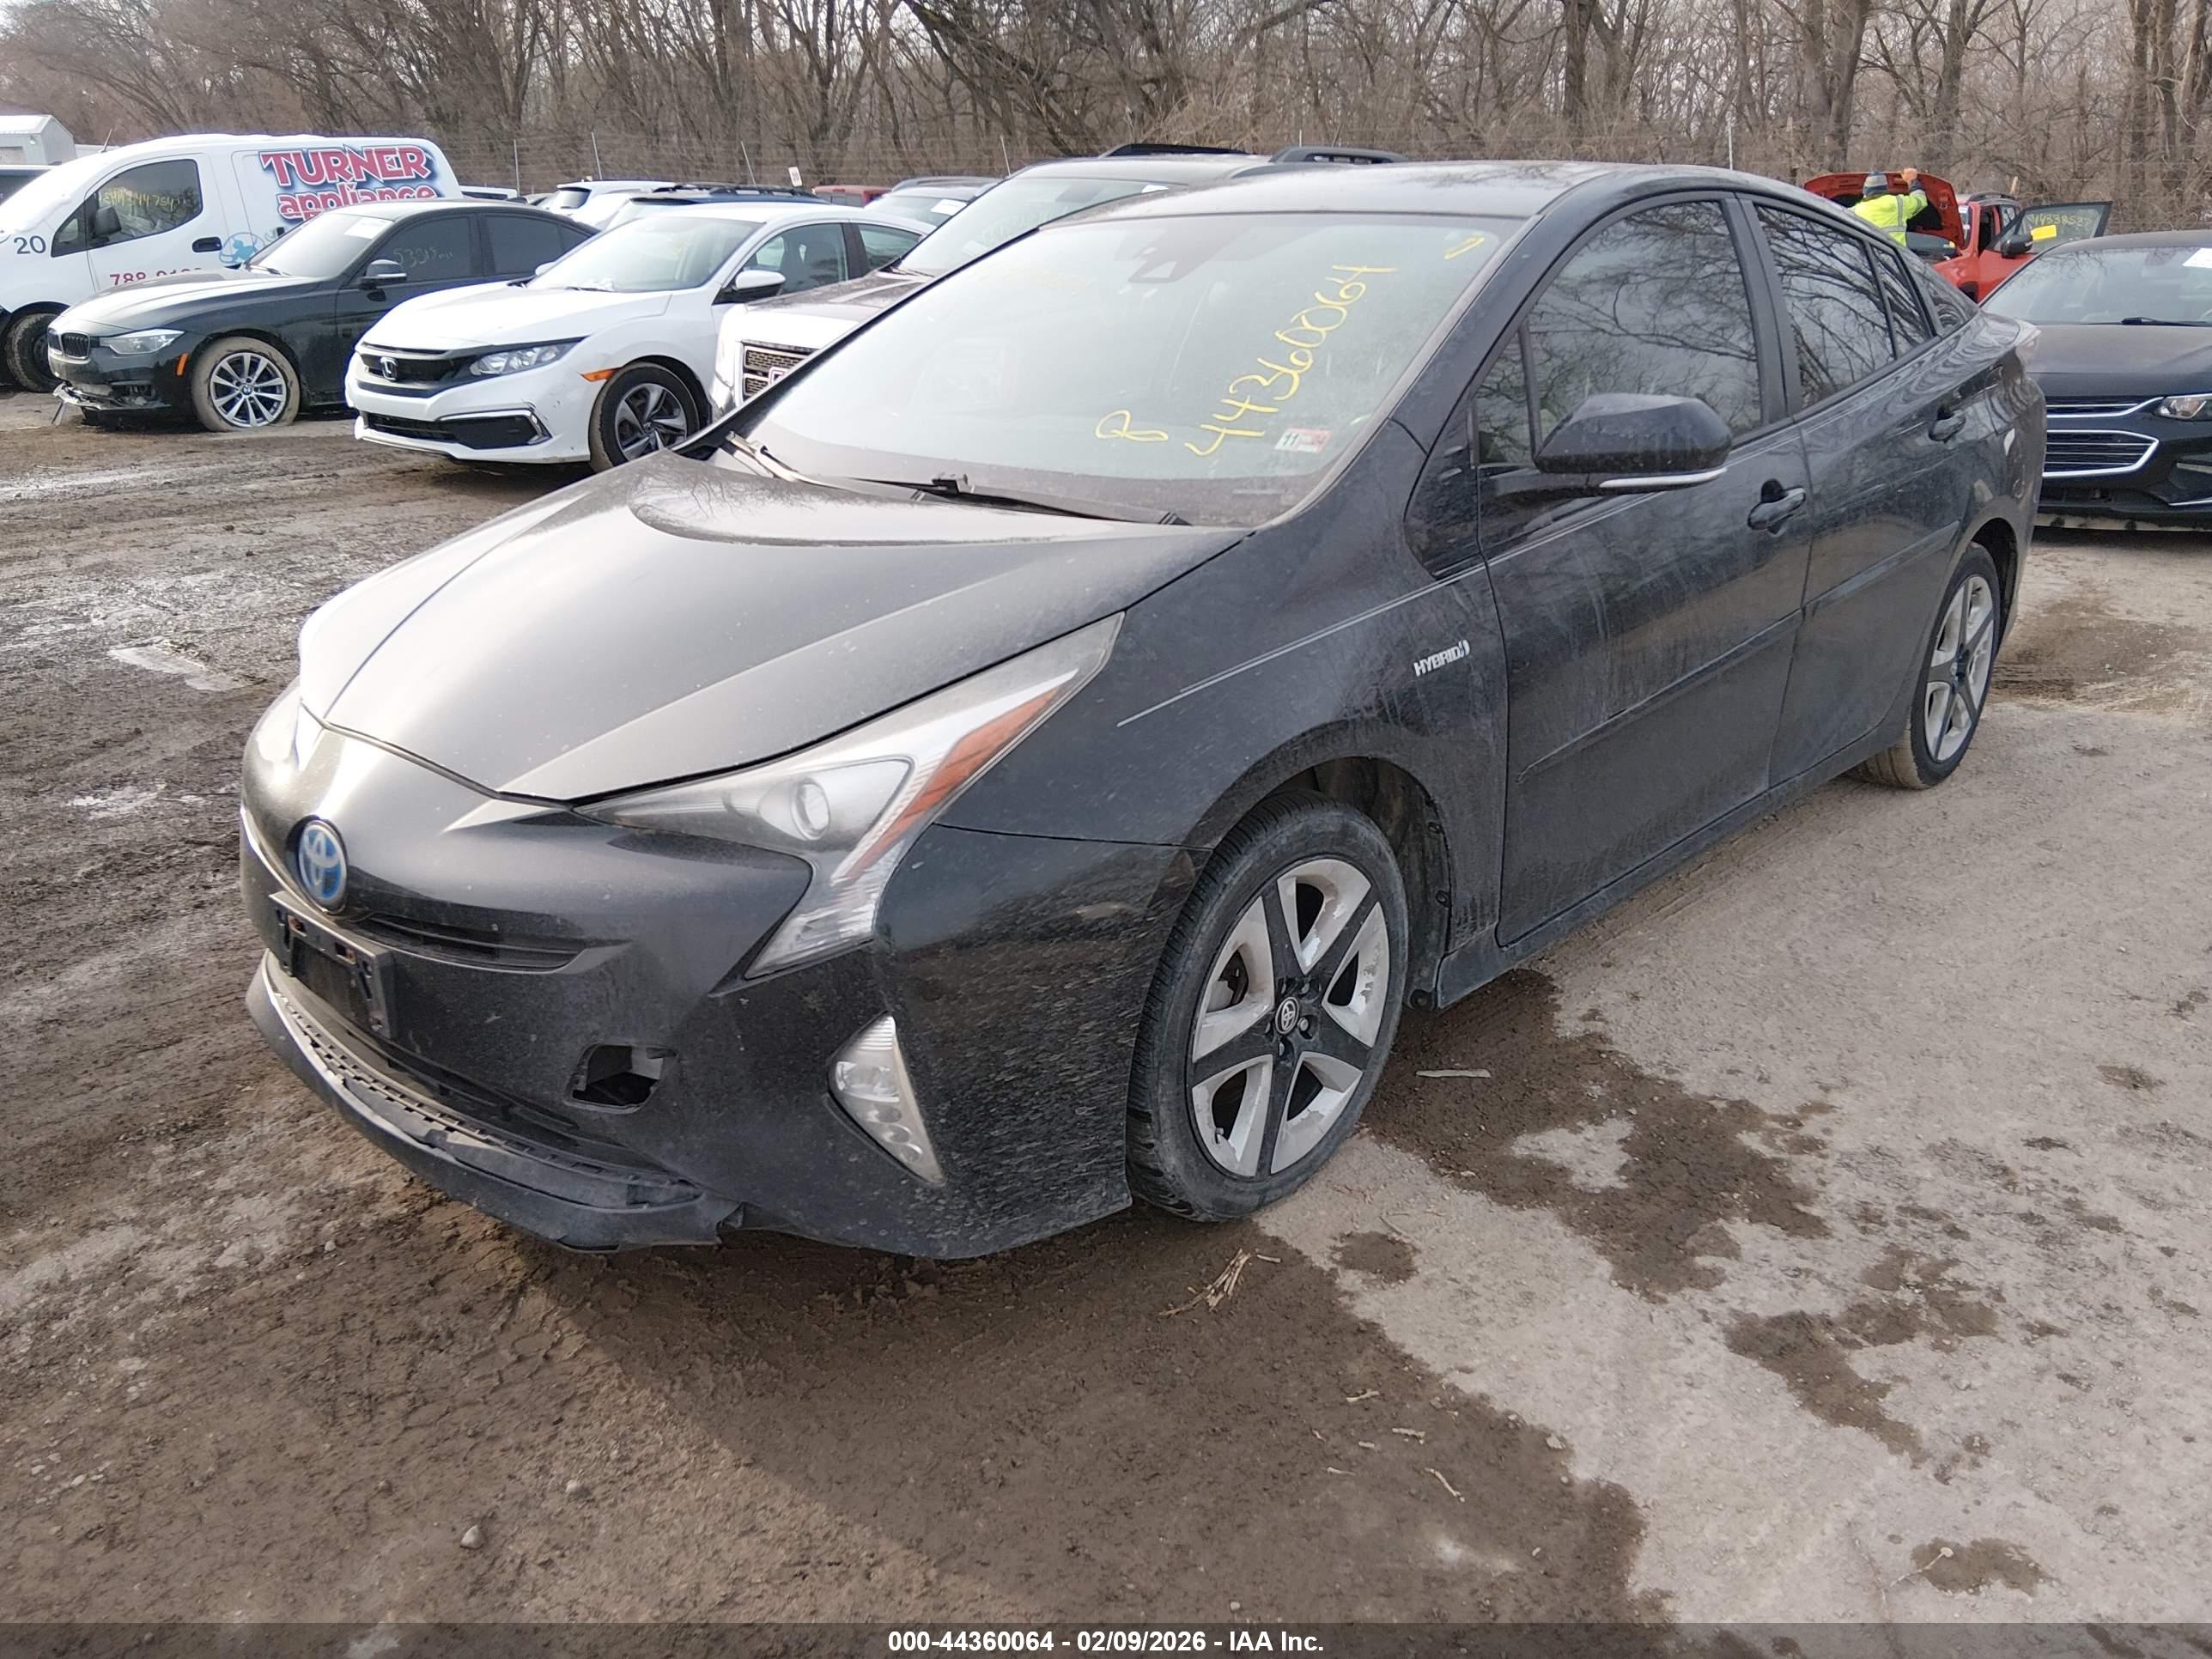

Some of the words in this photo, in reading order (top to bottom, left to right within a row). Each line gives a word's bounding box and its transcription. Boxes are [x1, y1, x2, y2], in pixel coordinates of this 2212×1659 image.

[259, 144, 432, 187] TURNER
[13, 235, 46, 255] 20
[1185, 264, 1399, 457] 44360064
[1413, 644, 1464, 677] HYBRID
